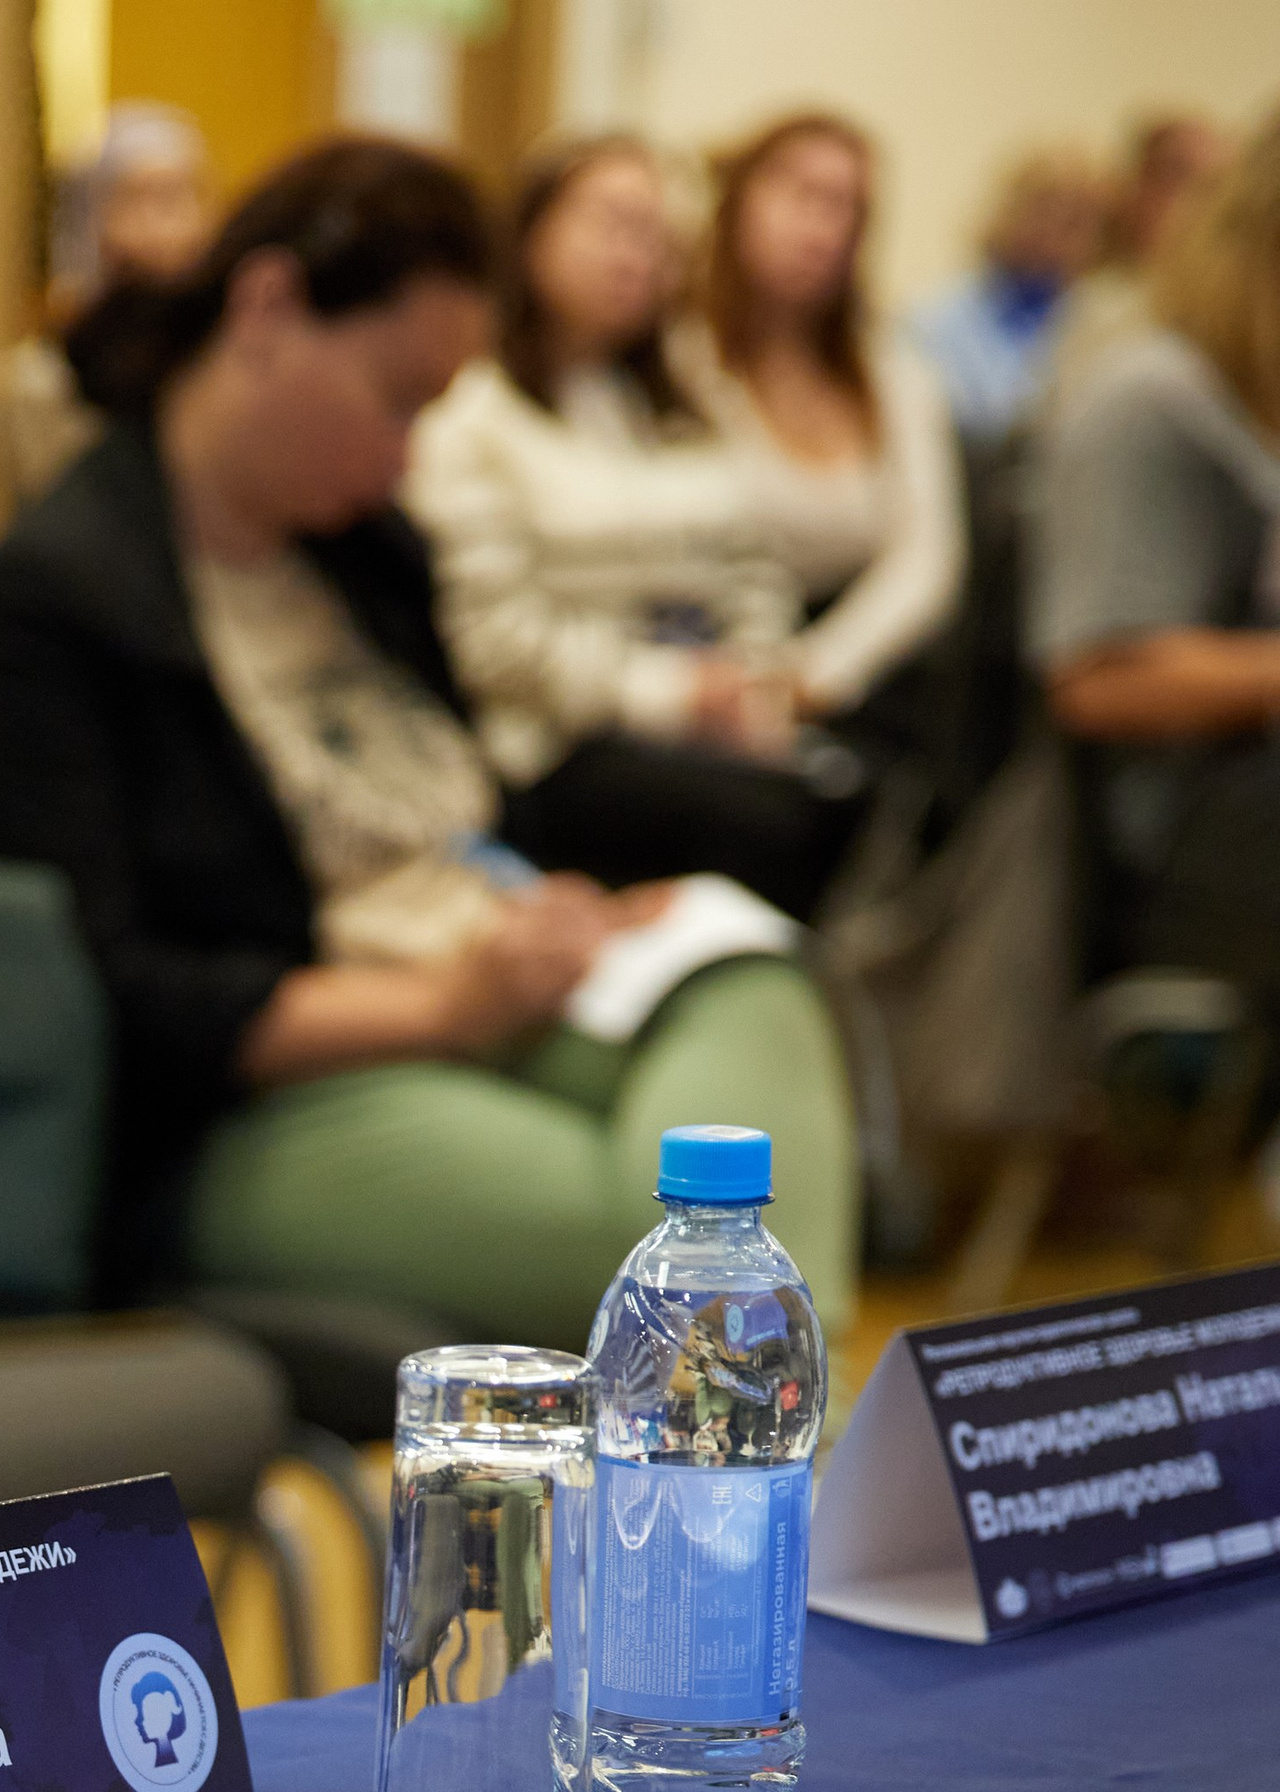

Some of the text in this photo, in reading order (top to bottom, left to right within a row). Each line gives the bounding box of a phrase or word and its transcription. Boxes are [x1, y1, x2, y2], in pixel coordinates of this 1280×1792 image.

[950, 1389, 1181, 1471] Спиридонова
[967, 1450, 1220, 1542] Владимировна
[769, 1521, 787, 1696] Негазированная
